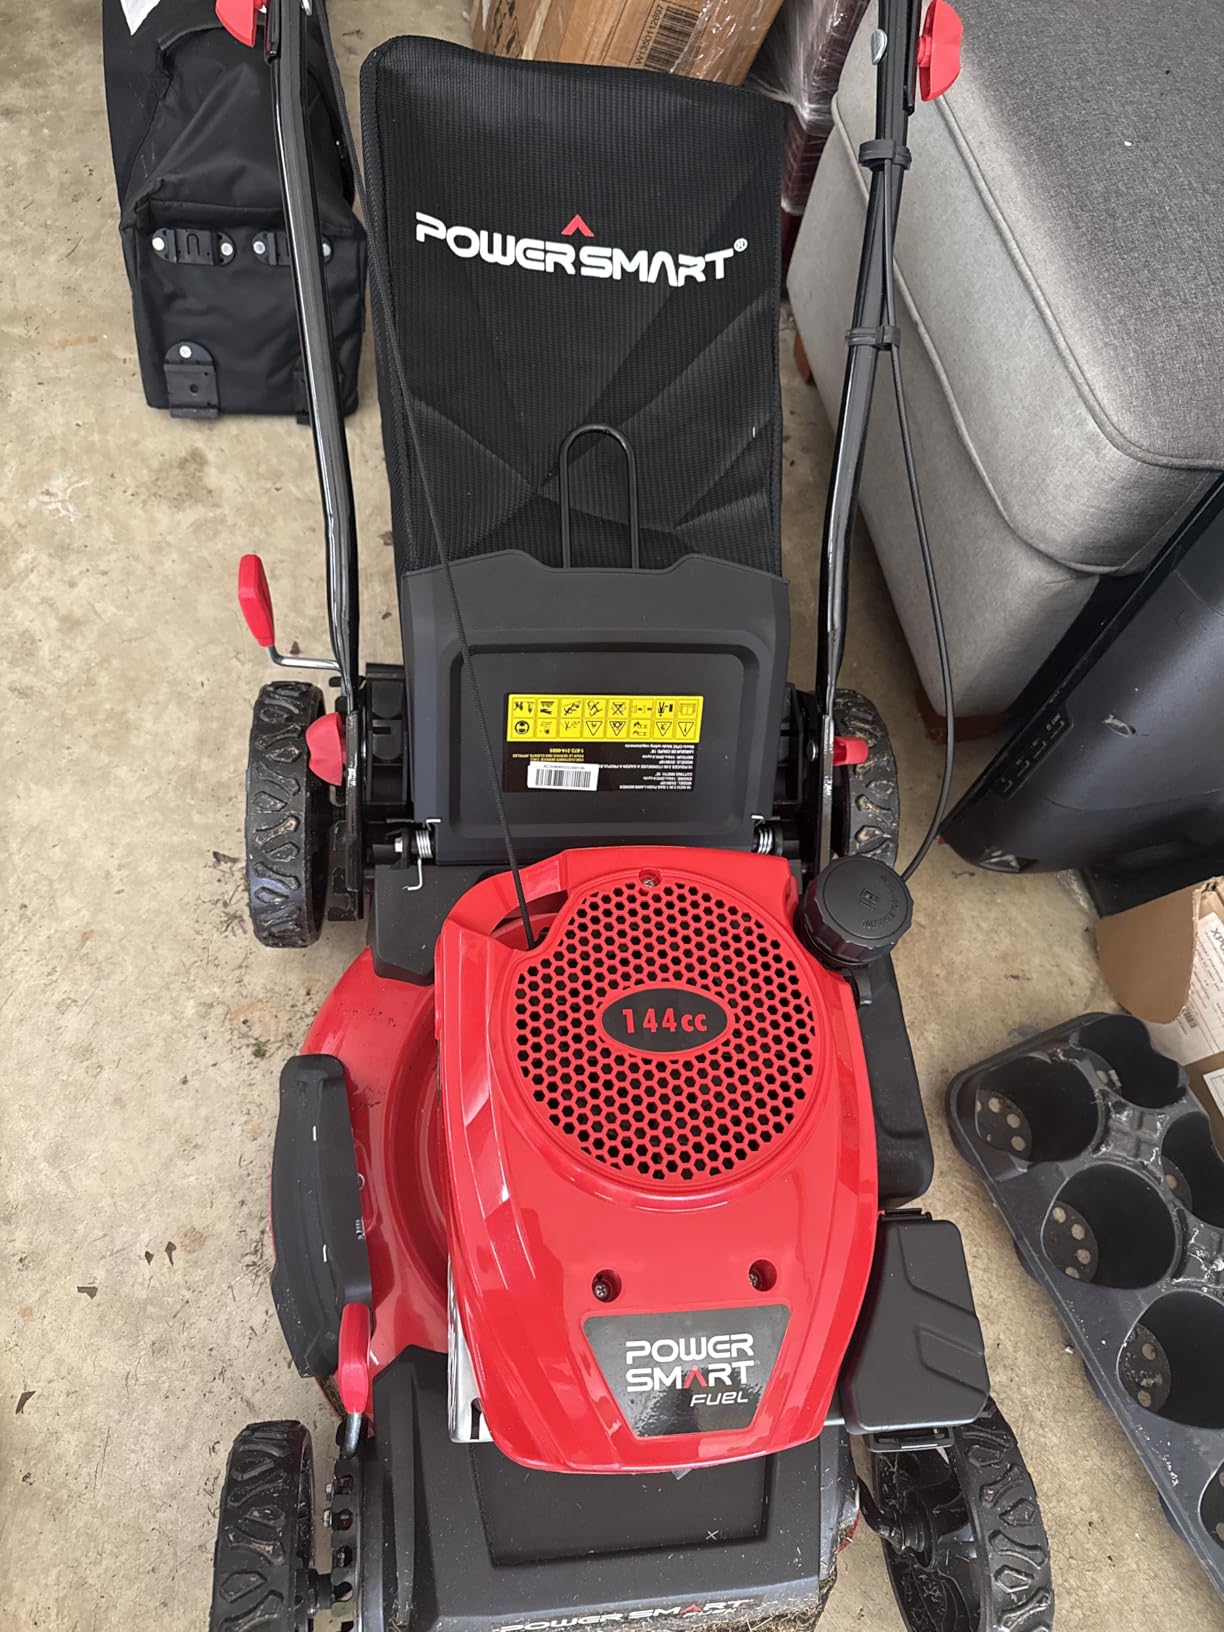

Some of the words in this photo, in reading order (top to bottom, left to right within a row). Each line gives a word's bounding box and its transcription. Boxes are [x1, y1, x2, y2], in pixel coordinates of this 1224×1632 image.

[622, 1007, 708, 1034] 144cc
[625, 1333, 754, 1364] POWER
[626, 1360, 755, 1392] SMART
[689, 1391, 749, 1407] FUEL
